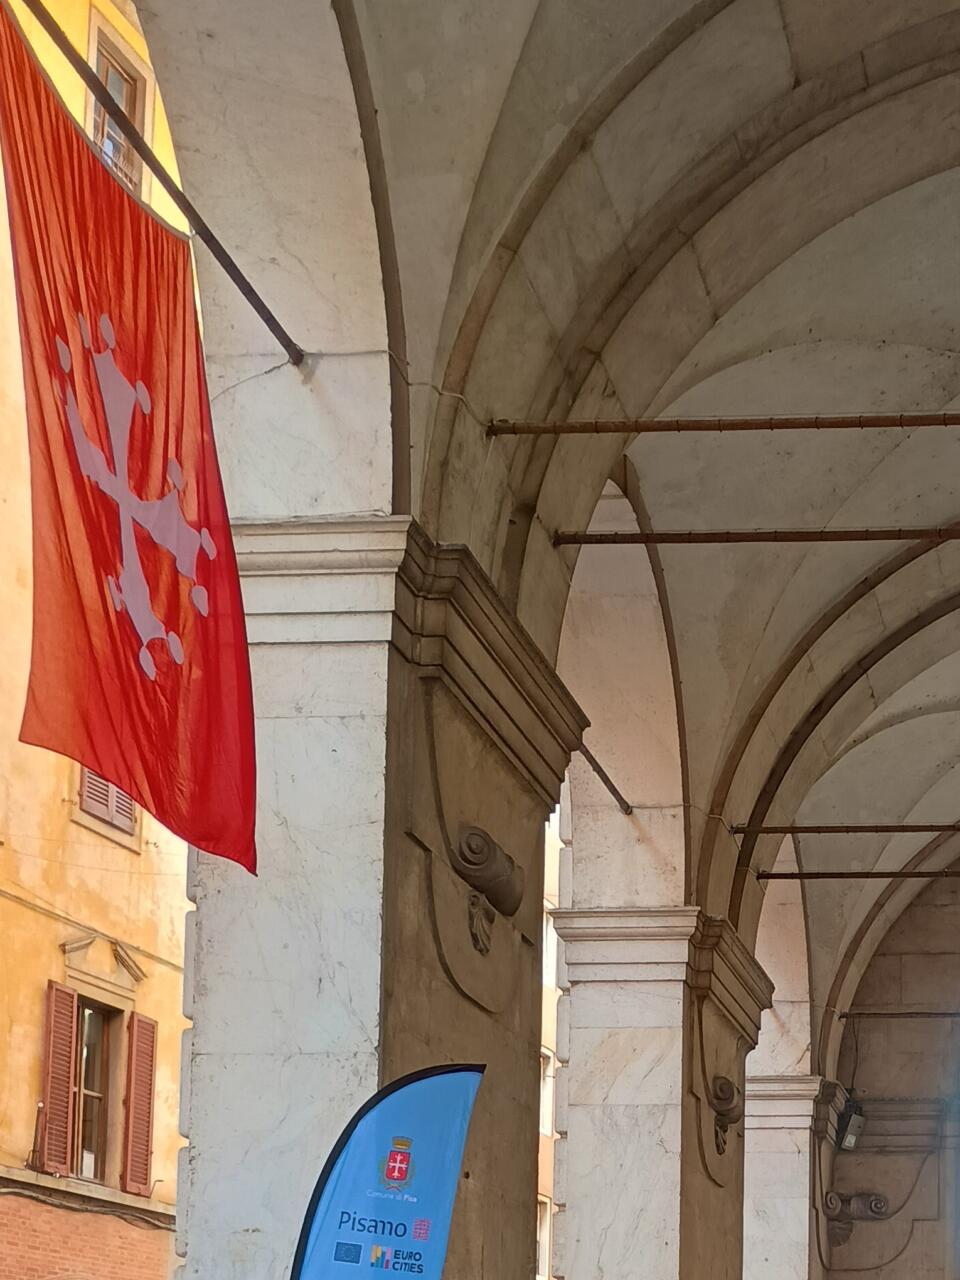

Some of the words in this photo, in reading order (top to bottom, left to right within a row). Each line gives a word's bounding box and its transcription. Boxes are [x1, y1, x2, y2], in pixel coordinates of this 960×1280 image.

[338, 1211, 407, 1239] Pisamo
[393, 1250, 422, 1262] EURO
[392, 1261, 424, 1274] CITIES
